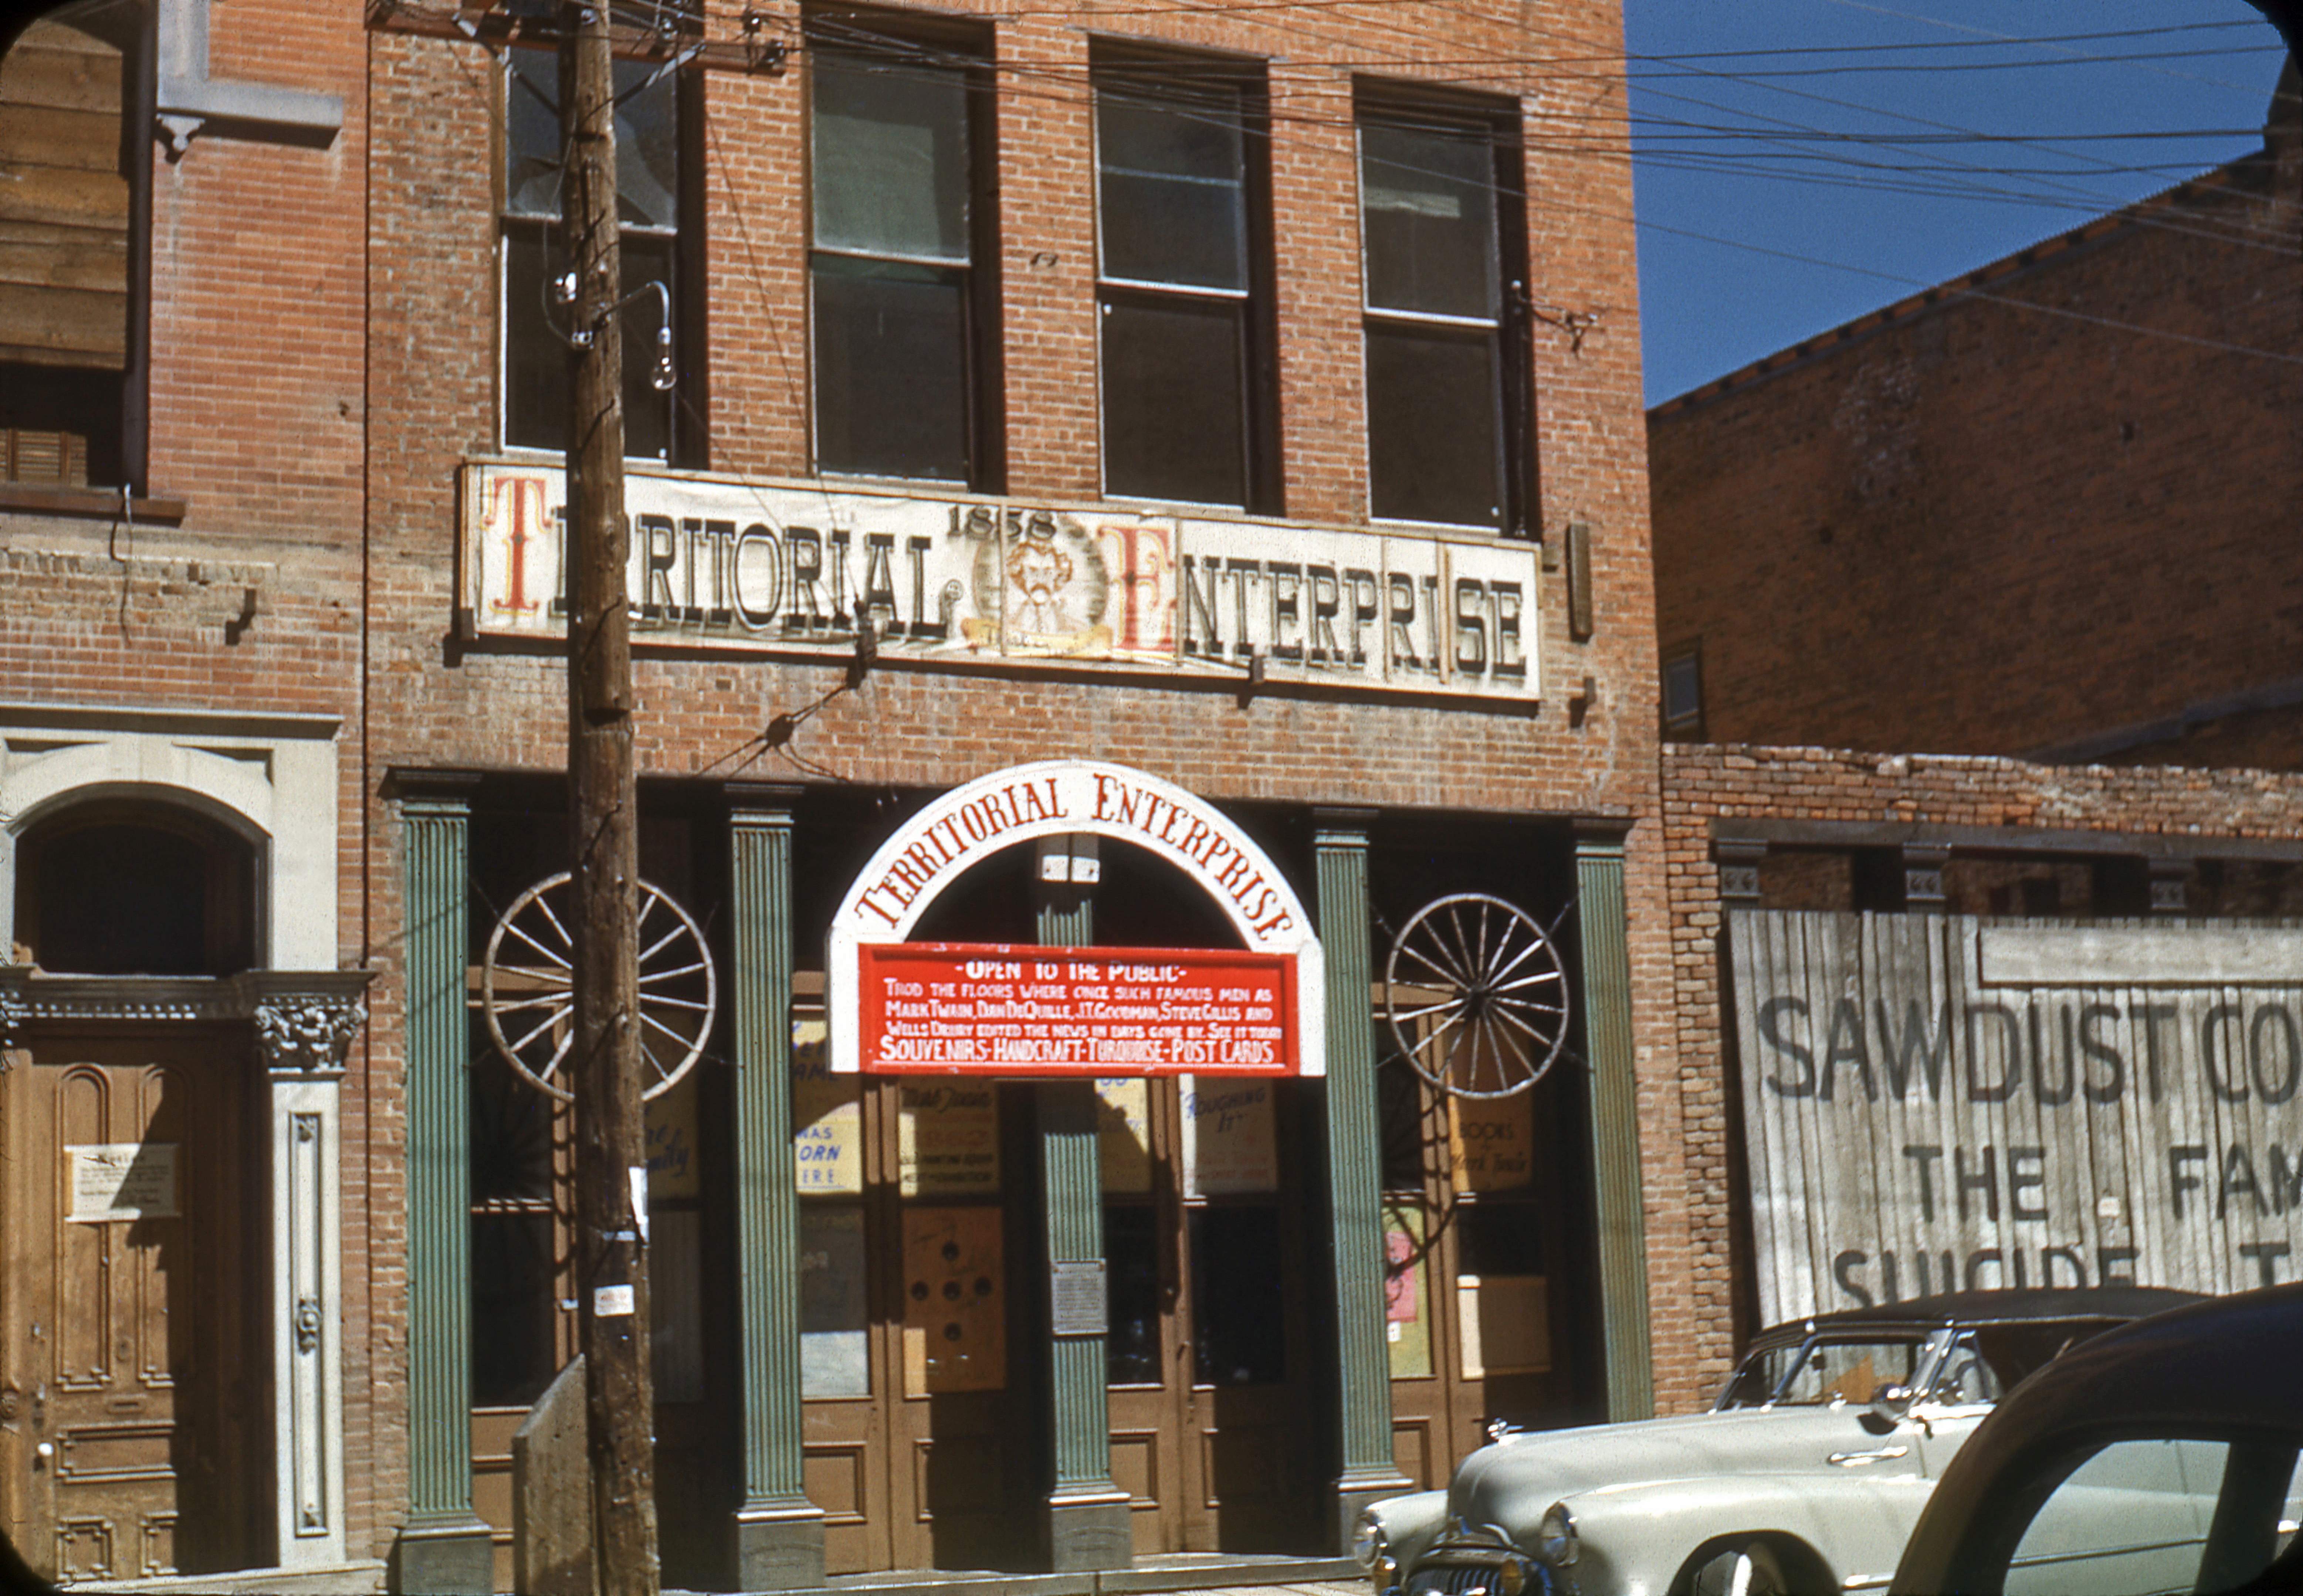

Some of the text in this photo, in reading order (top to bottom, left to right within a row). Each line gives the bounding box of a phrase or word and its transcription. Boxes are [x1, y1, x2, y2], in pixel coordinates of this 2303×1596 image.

[481, 476, 948, 642] TRITORIAL
[1097, 525, 1527, 677] ENTERPRISE
[854, 773, 1293, 941] TERRITORIAL ENTERPRISE
[930, 982, 956, 997] THE
[1254, 988, 1273, 1002] AS
[1036, 962, 1059, 980] TO
[1068, 962, 1101, 981] THE
[795, 1145, 841, 1162] ORN
[1902, 1145, 2049, 1223] THE
